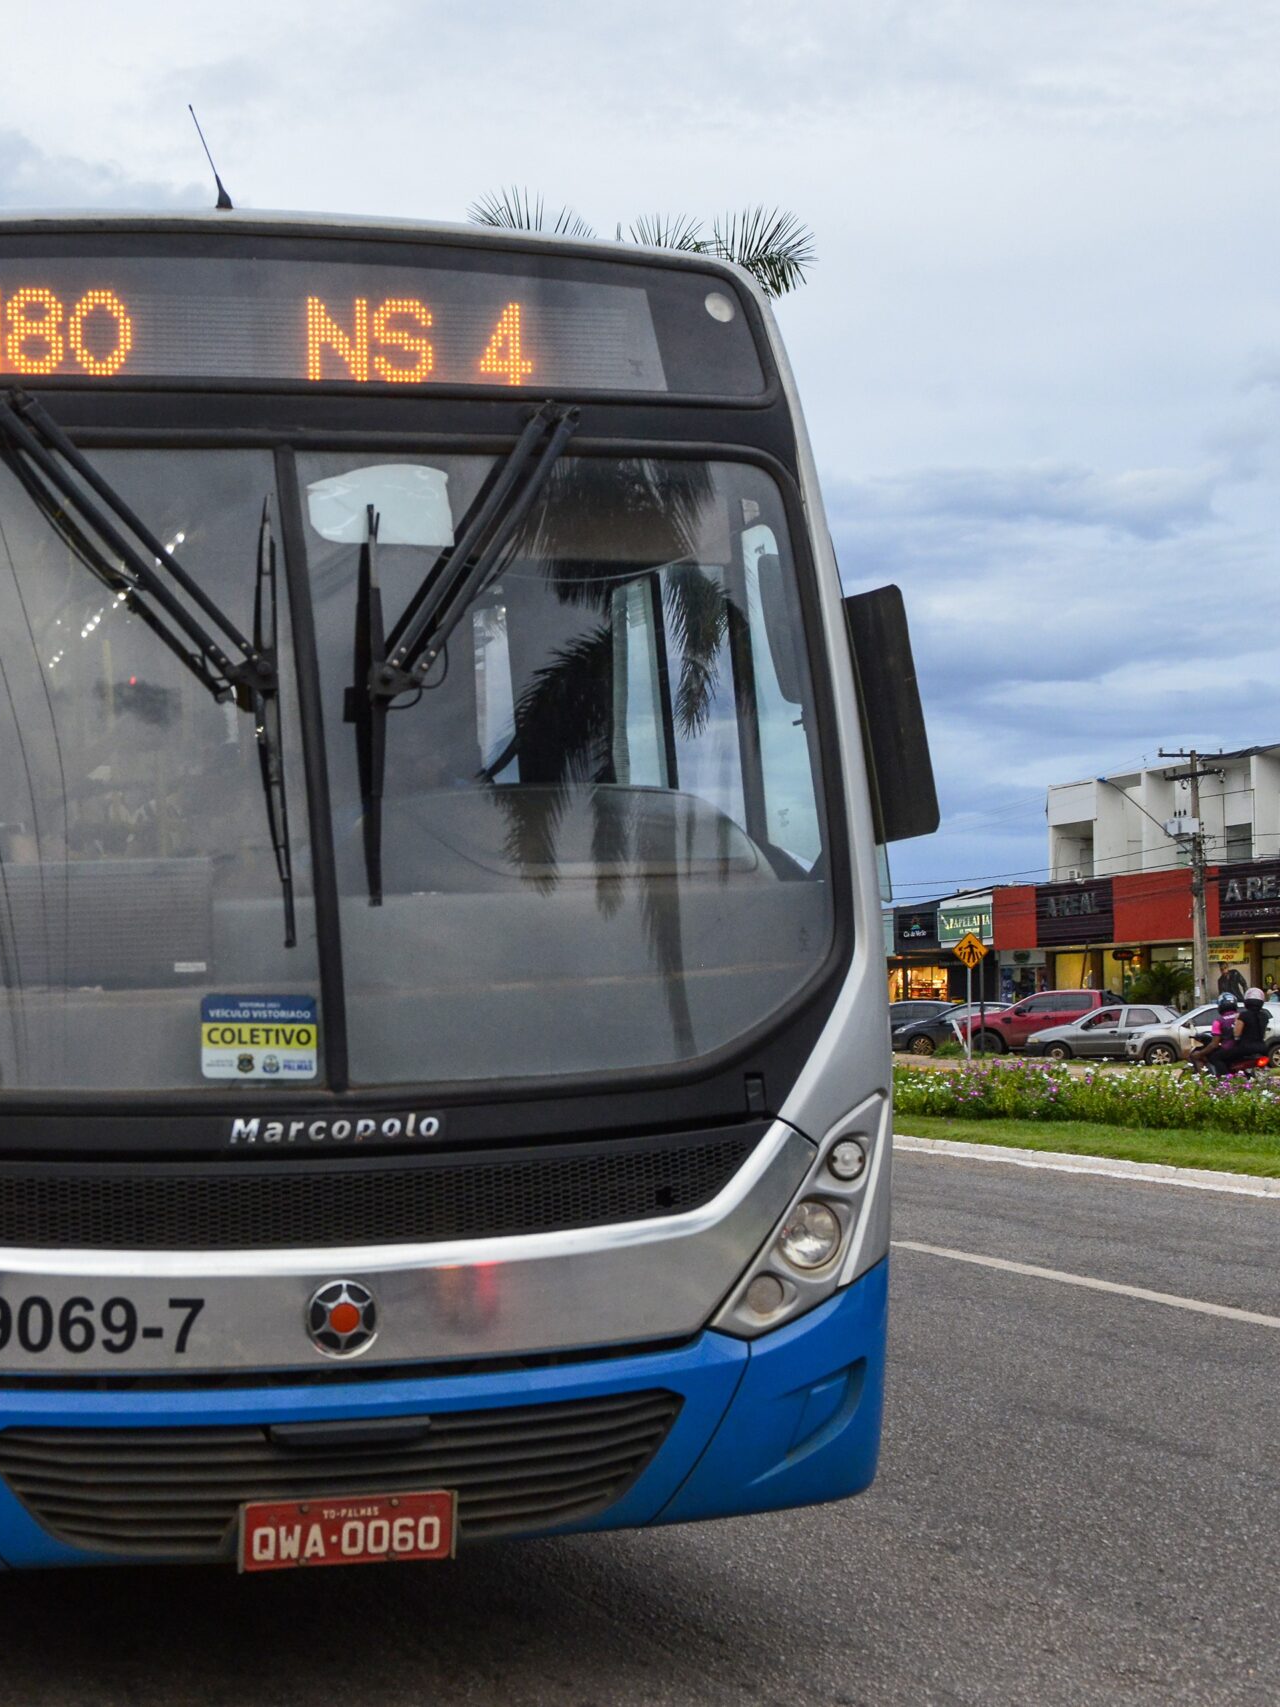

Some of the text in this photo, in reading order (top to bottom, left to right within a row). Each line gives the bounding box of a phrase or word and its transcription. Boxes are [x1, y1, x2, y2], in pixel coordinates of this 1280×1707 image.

[307, 297, 433, 382] NS
[480, 303, 531, 384] 4
[252, 1009, 311, 1019] VISTORIADO
[207, 1027, 312, 1046] COLETIVO
[230, 1113, 439, 1143] Marcopolo
